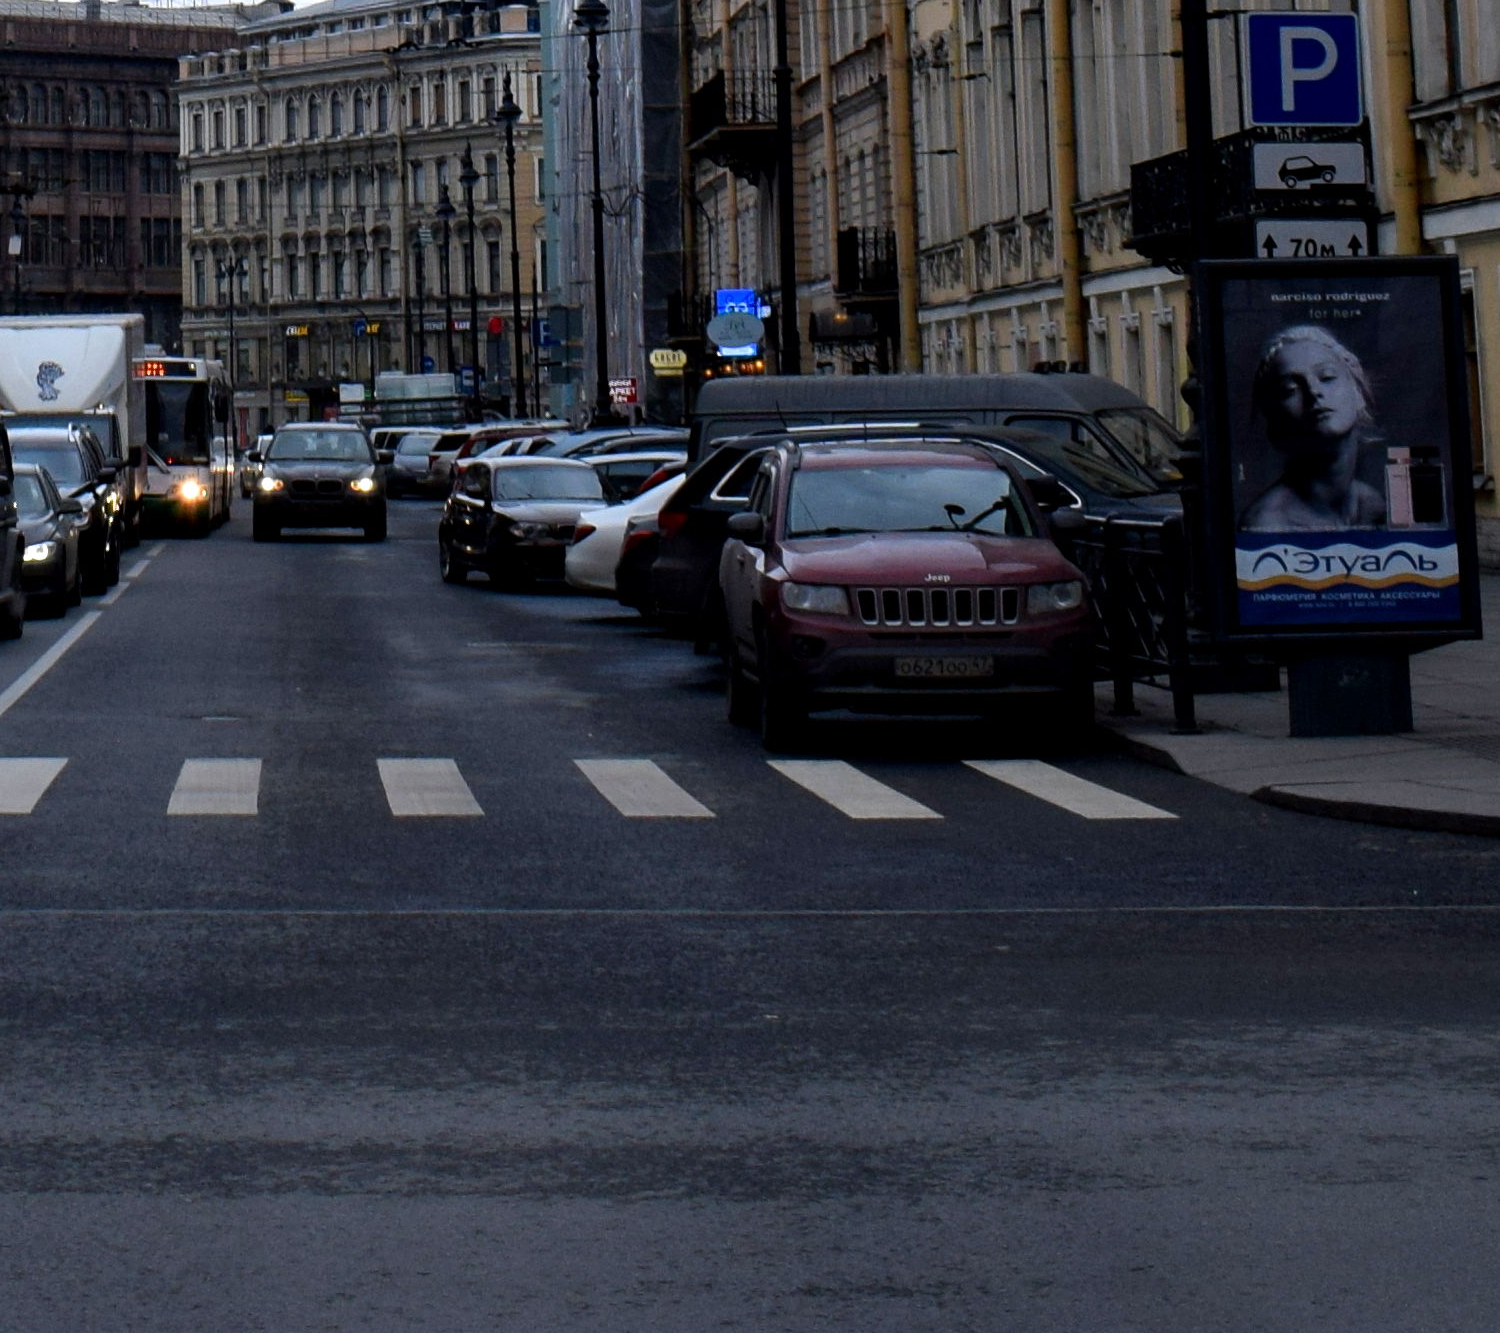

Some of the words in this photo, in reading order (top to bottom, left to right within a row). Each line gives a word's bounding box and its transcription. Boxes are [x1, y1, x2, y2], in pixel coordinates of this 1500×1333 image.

[1279, 25, 1339, 113] P
[1270, 291, 1321, 302] narciso
[1324, 290, 1391, 304] rodriguez
[1309, 307, 1328, 320] for
[924, 572, 951, 584] Jeep
